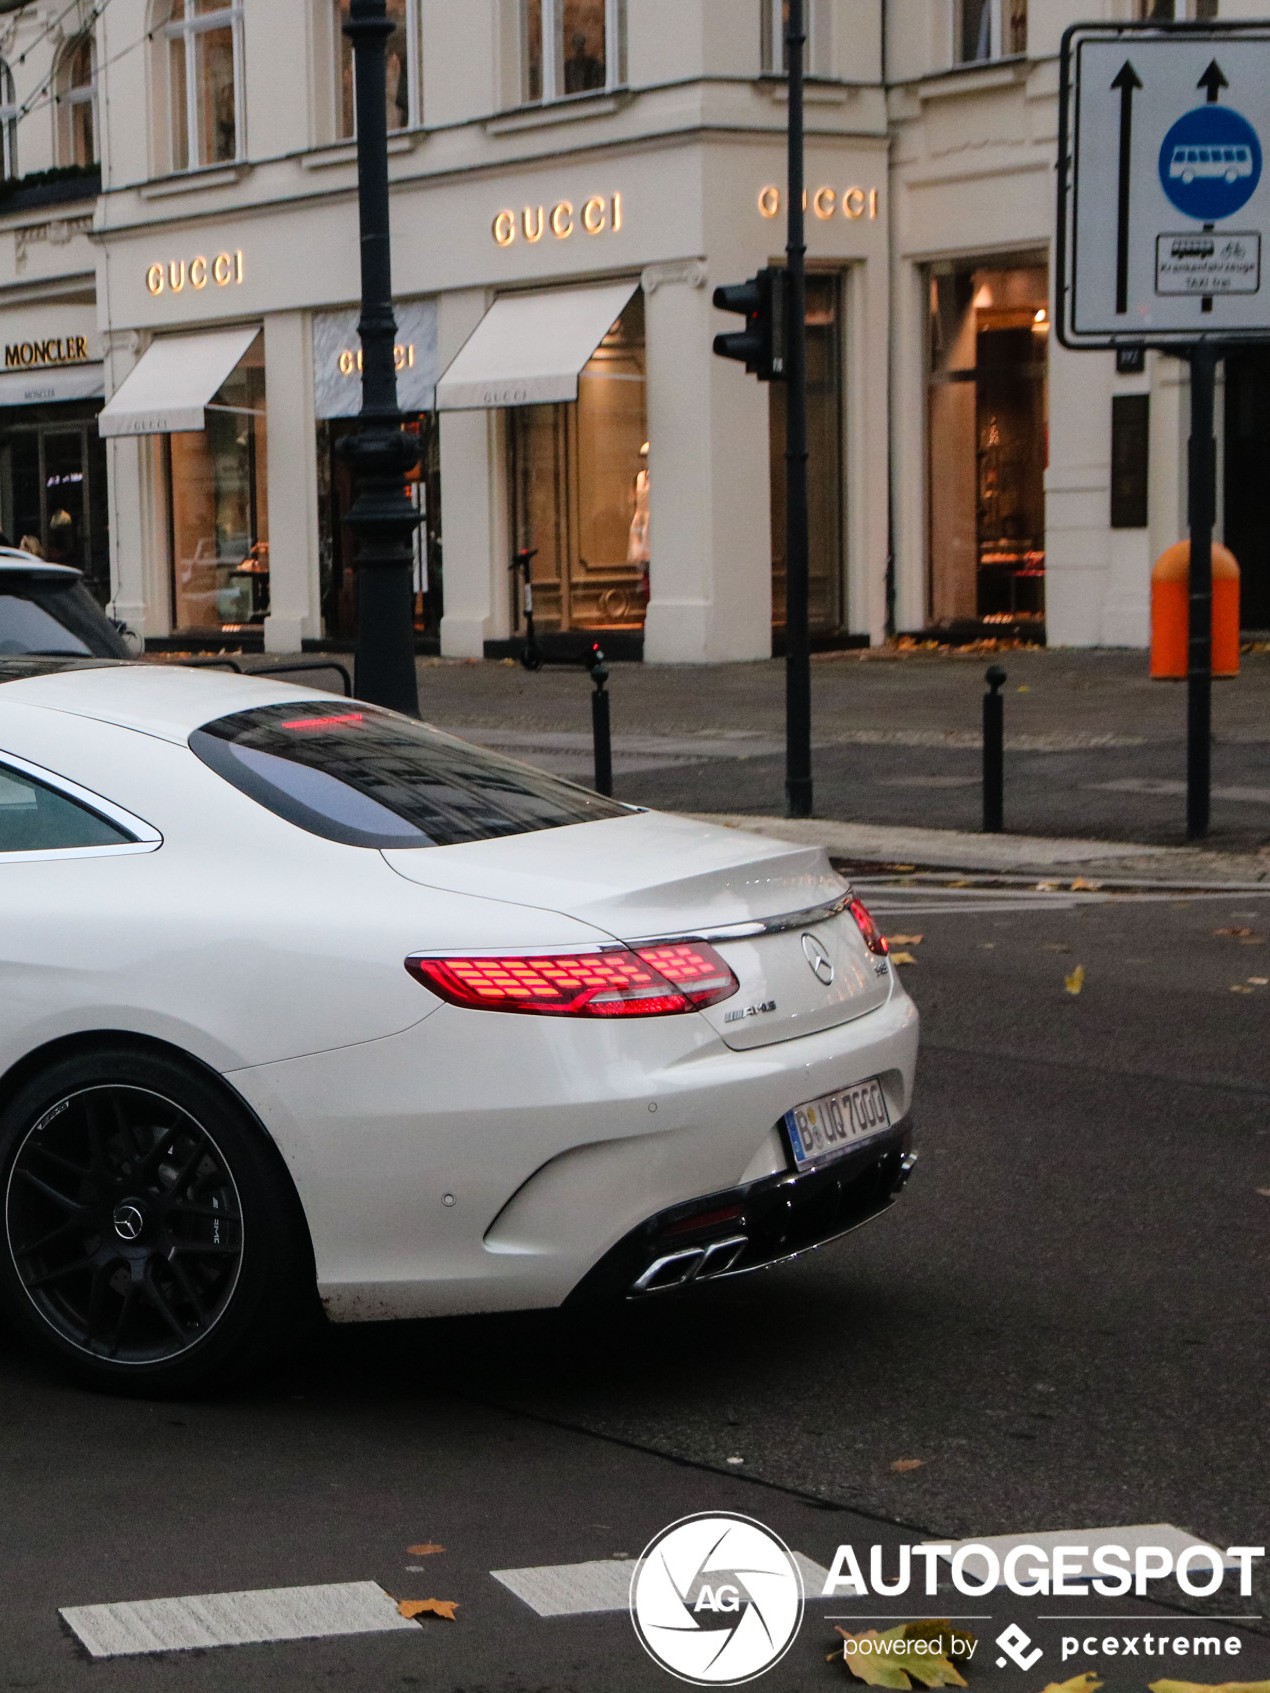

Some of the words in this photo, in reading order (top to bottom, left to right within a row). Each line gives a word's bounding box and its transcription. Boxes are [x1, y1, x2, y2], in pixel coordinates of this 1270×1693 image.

[492, 190, 622, 247] GUCCI
[757, 185, 877, 220] GCCI
[145, 248, 244, 296] GUCCI
[5, 334, 88, 367] MONCLER
[338, 344, 414, 375] GCI
[483, 389, 527, 403] GUCCI
[795, 1110, 814, 1152] B
[841, 1084, 886, 1134] 7000
